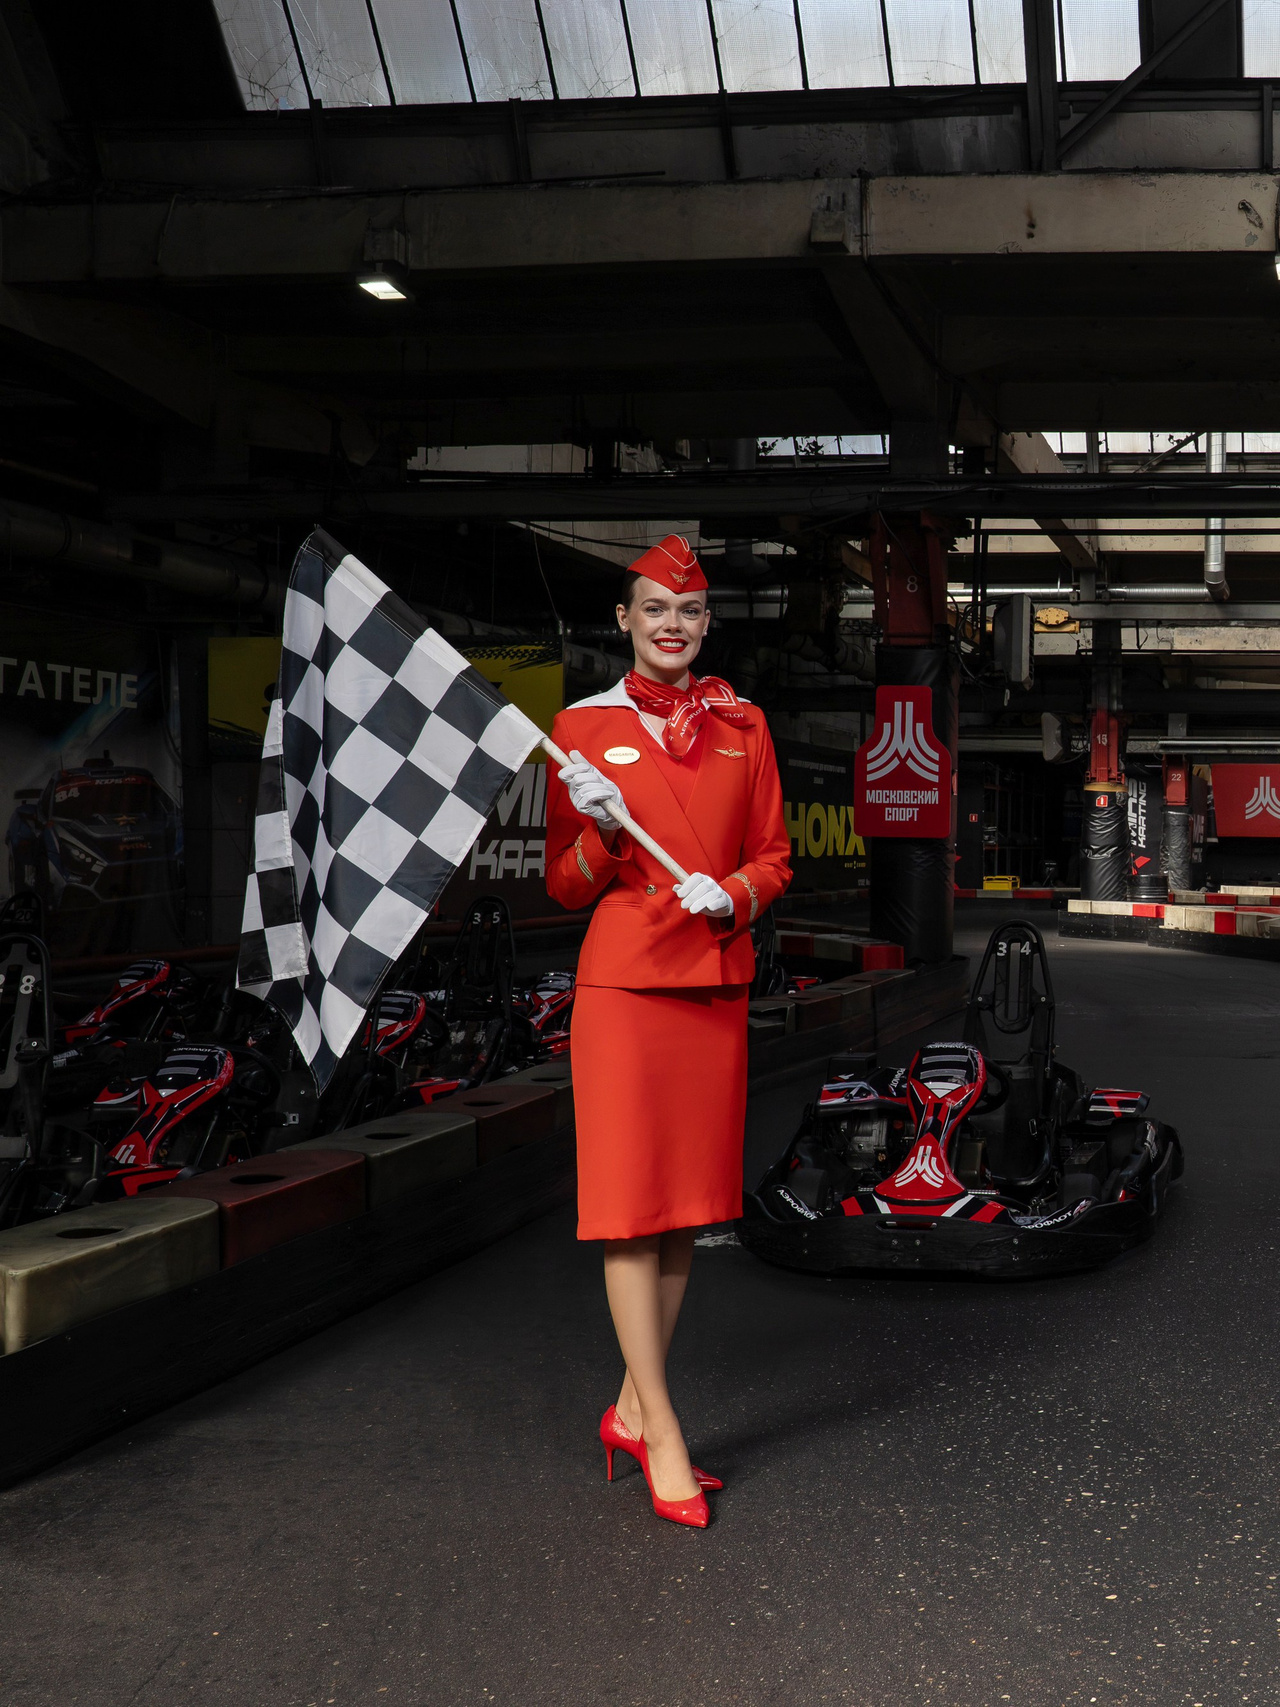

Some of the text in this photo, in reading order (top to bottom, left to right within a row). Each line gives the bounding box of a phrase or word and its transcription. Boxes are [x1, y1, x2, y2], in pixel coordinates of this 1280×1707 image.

[906, 575, 918, 593] 8
[1171, 773, 1182, 782] 22
[866, 787, 940, 805] МОСКОВСКИЙ
[884, 807, 920, 821] СПОРТ
